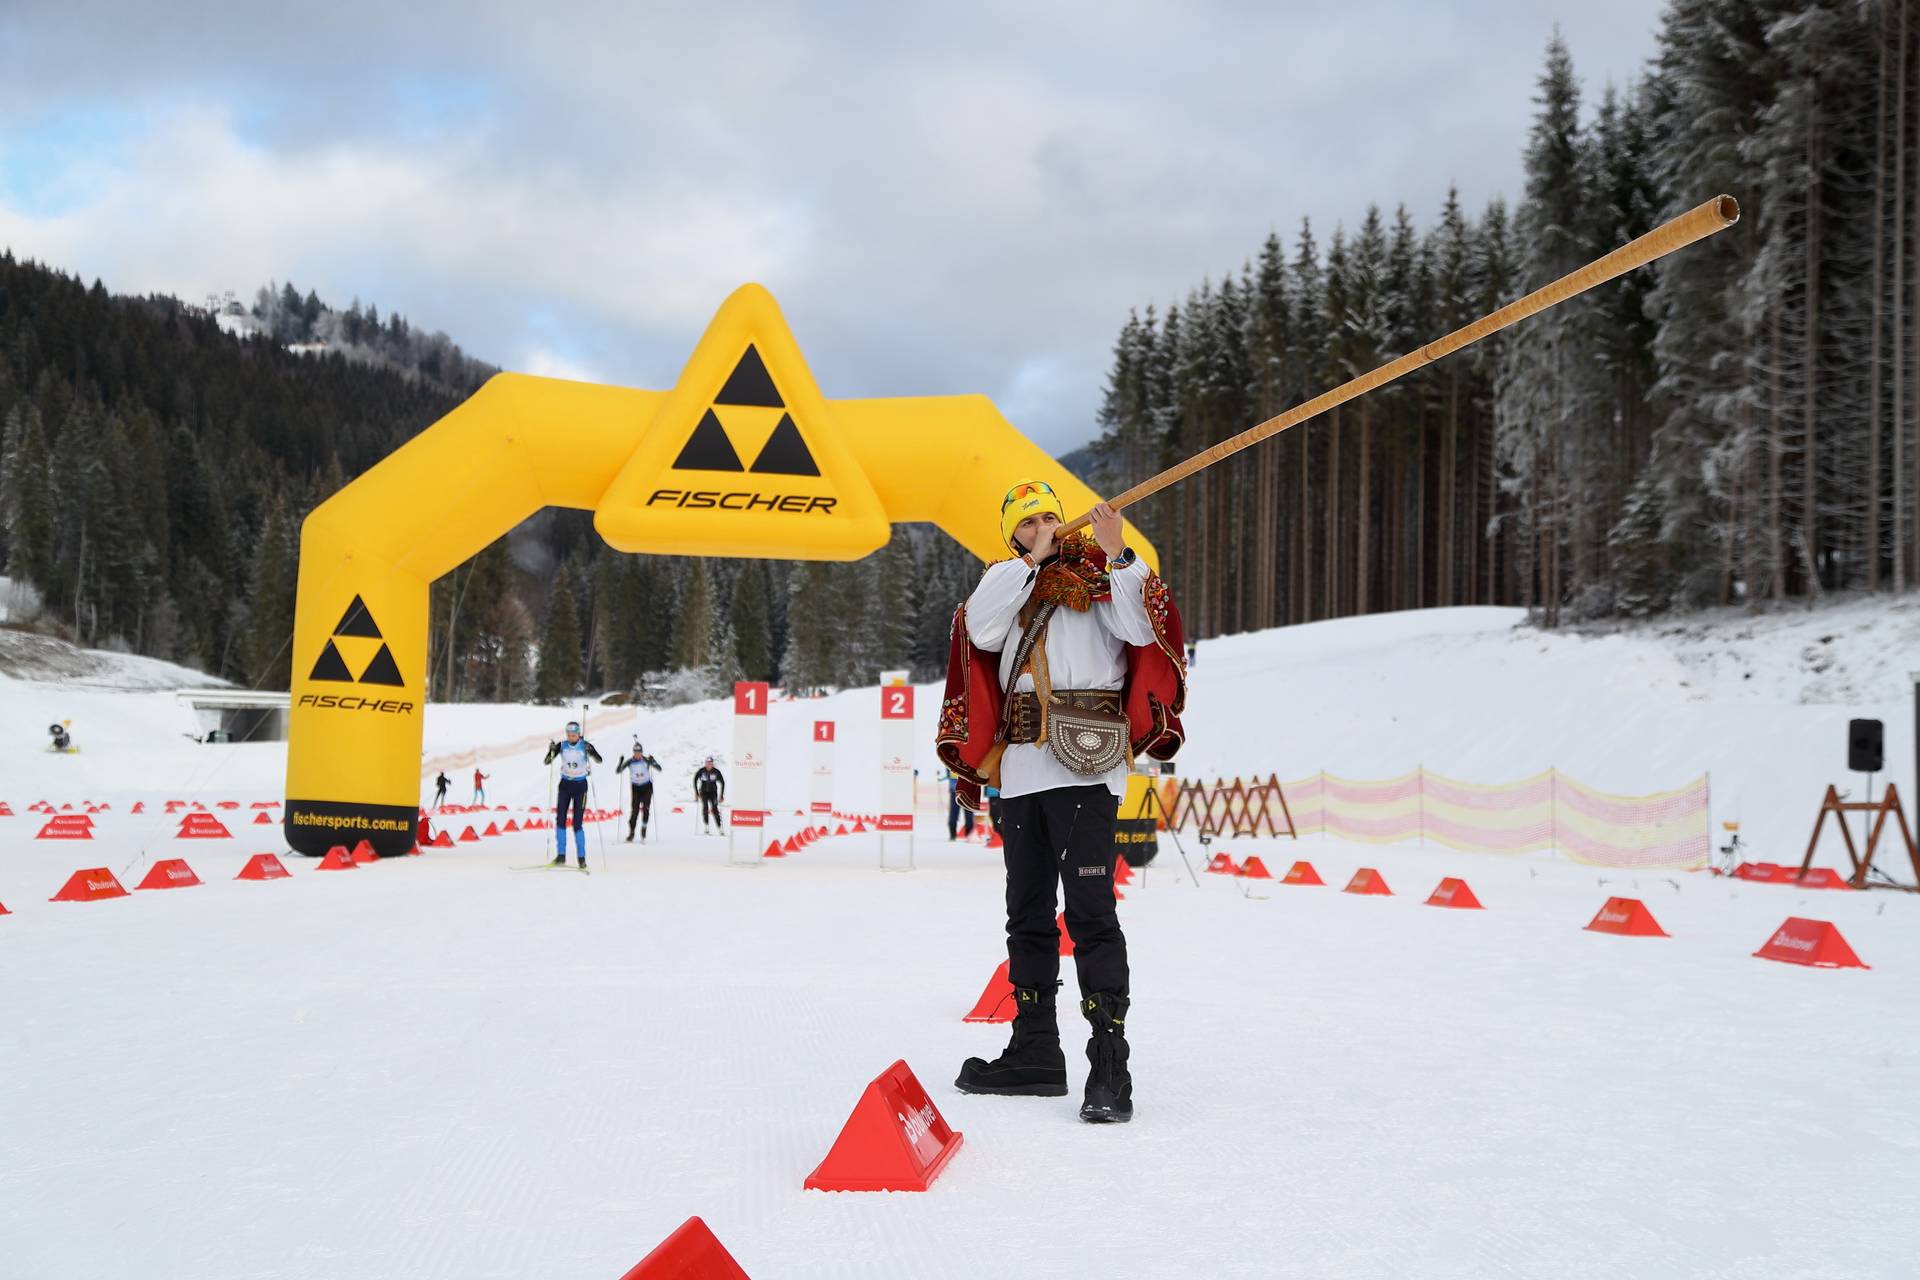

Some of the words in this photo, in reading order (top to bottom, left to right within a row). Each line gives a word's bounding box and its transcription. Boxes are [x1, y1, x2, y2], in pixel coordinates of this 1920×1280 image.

[646, 489, 838, 515] FISCHER
[298, 694, 414, 715] FISCHER
[745, 689, 757, 710] 1
[890, 693, 905, 713] 2
[819, 725, 829, 739] 1
[293, 811, 409, 832] fischersports.com.ua
